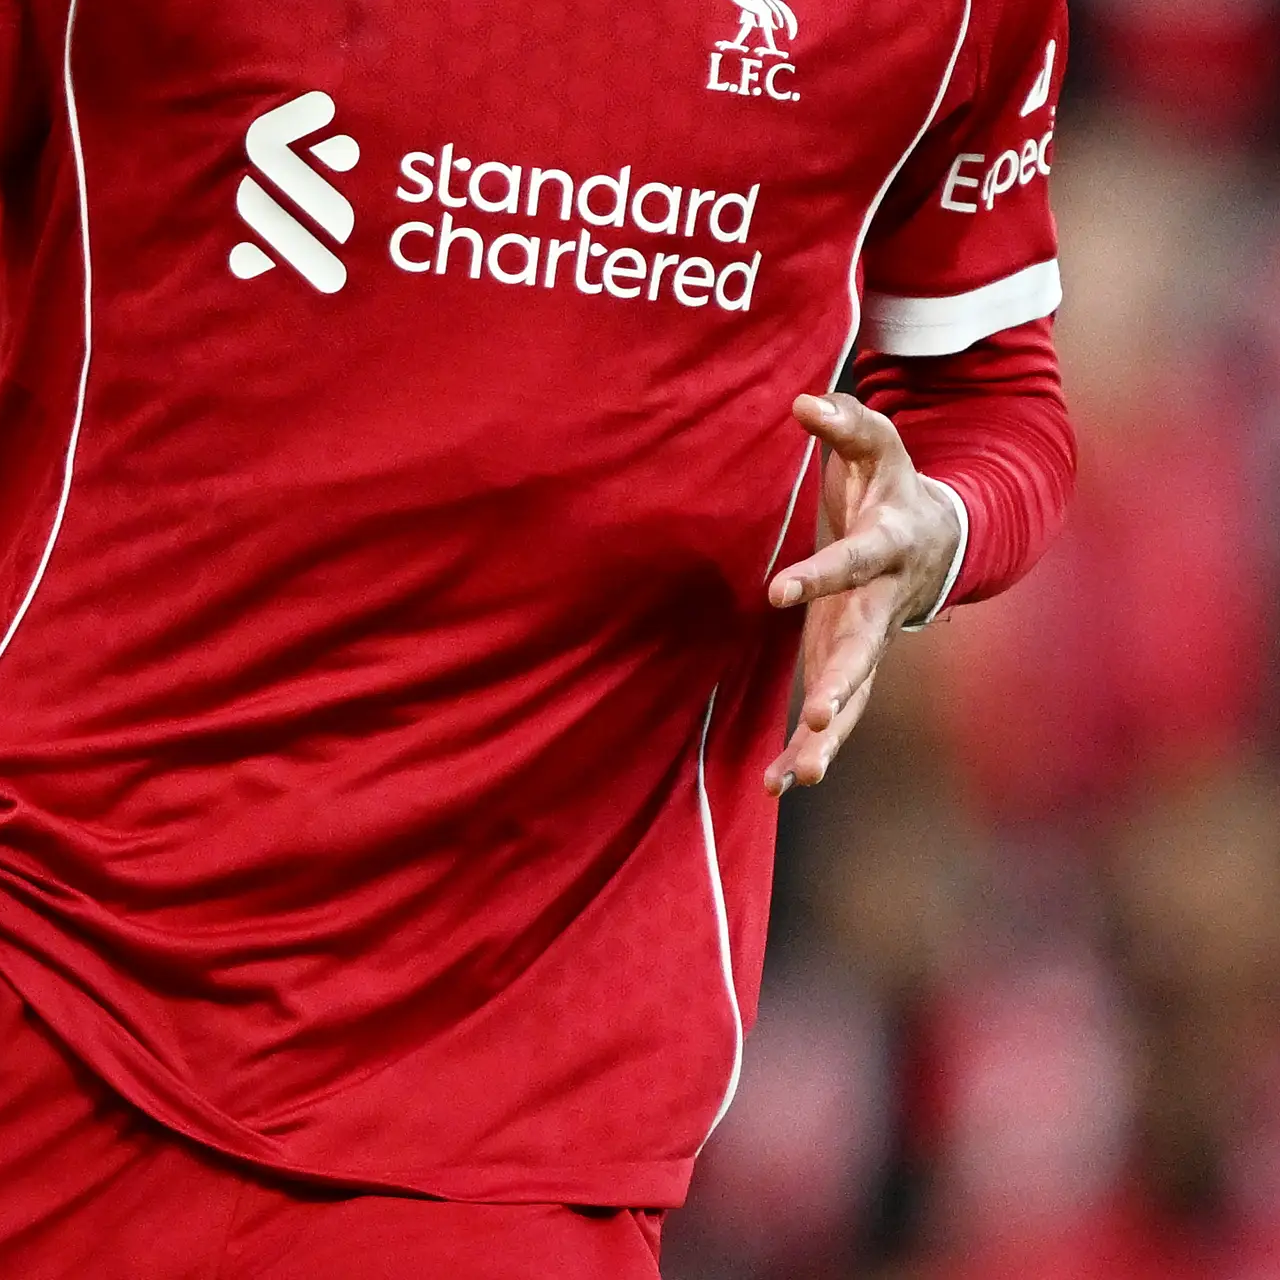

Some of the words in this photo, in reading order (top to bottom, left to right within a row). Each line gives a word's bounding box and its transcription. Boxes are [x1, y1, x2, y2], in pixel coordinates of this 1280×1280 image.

[705, 52, 801, 102] L.F.C.
[396, 142, 761, 244] standard
[389, 211, 763, 312] chartered
